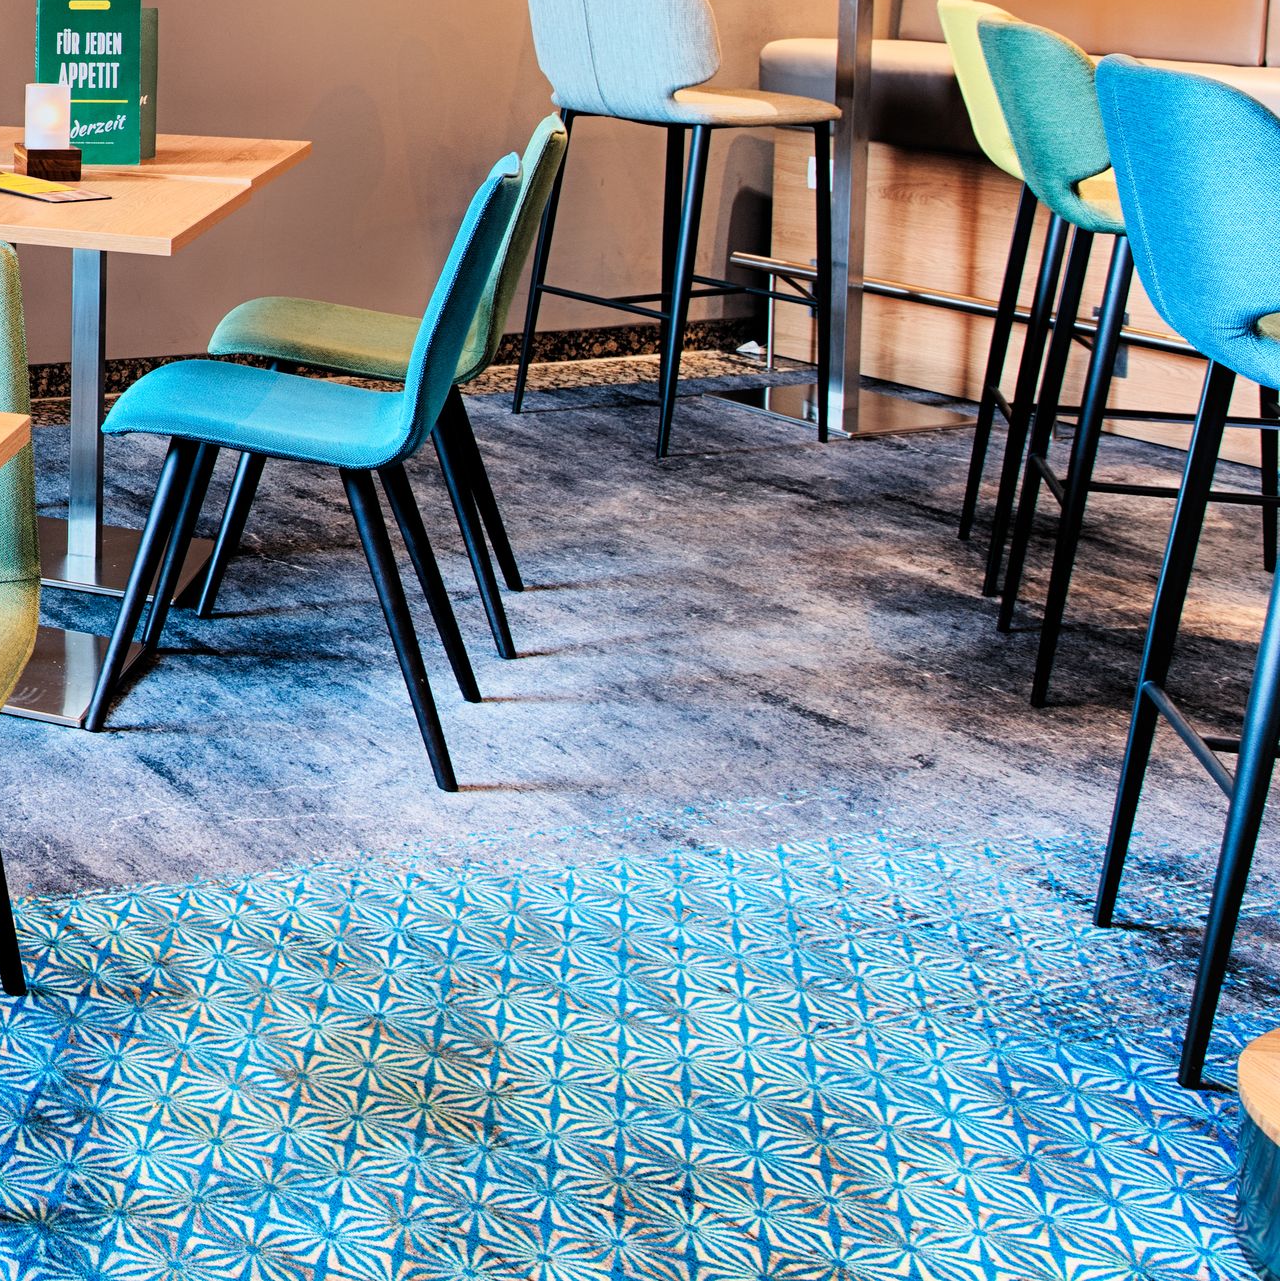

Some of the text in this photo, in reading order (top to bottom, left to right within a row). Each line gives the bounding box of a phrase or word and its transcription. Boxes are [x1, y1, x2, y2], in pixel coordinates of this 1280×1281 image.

[57, 28, 122, 55] FÜR JEDEN
[58, 62, 120, 89] APPETIT
[70, 114, 127, 139] derzeit
